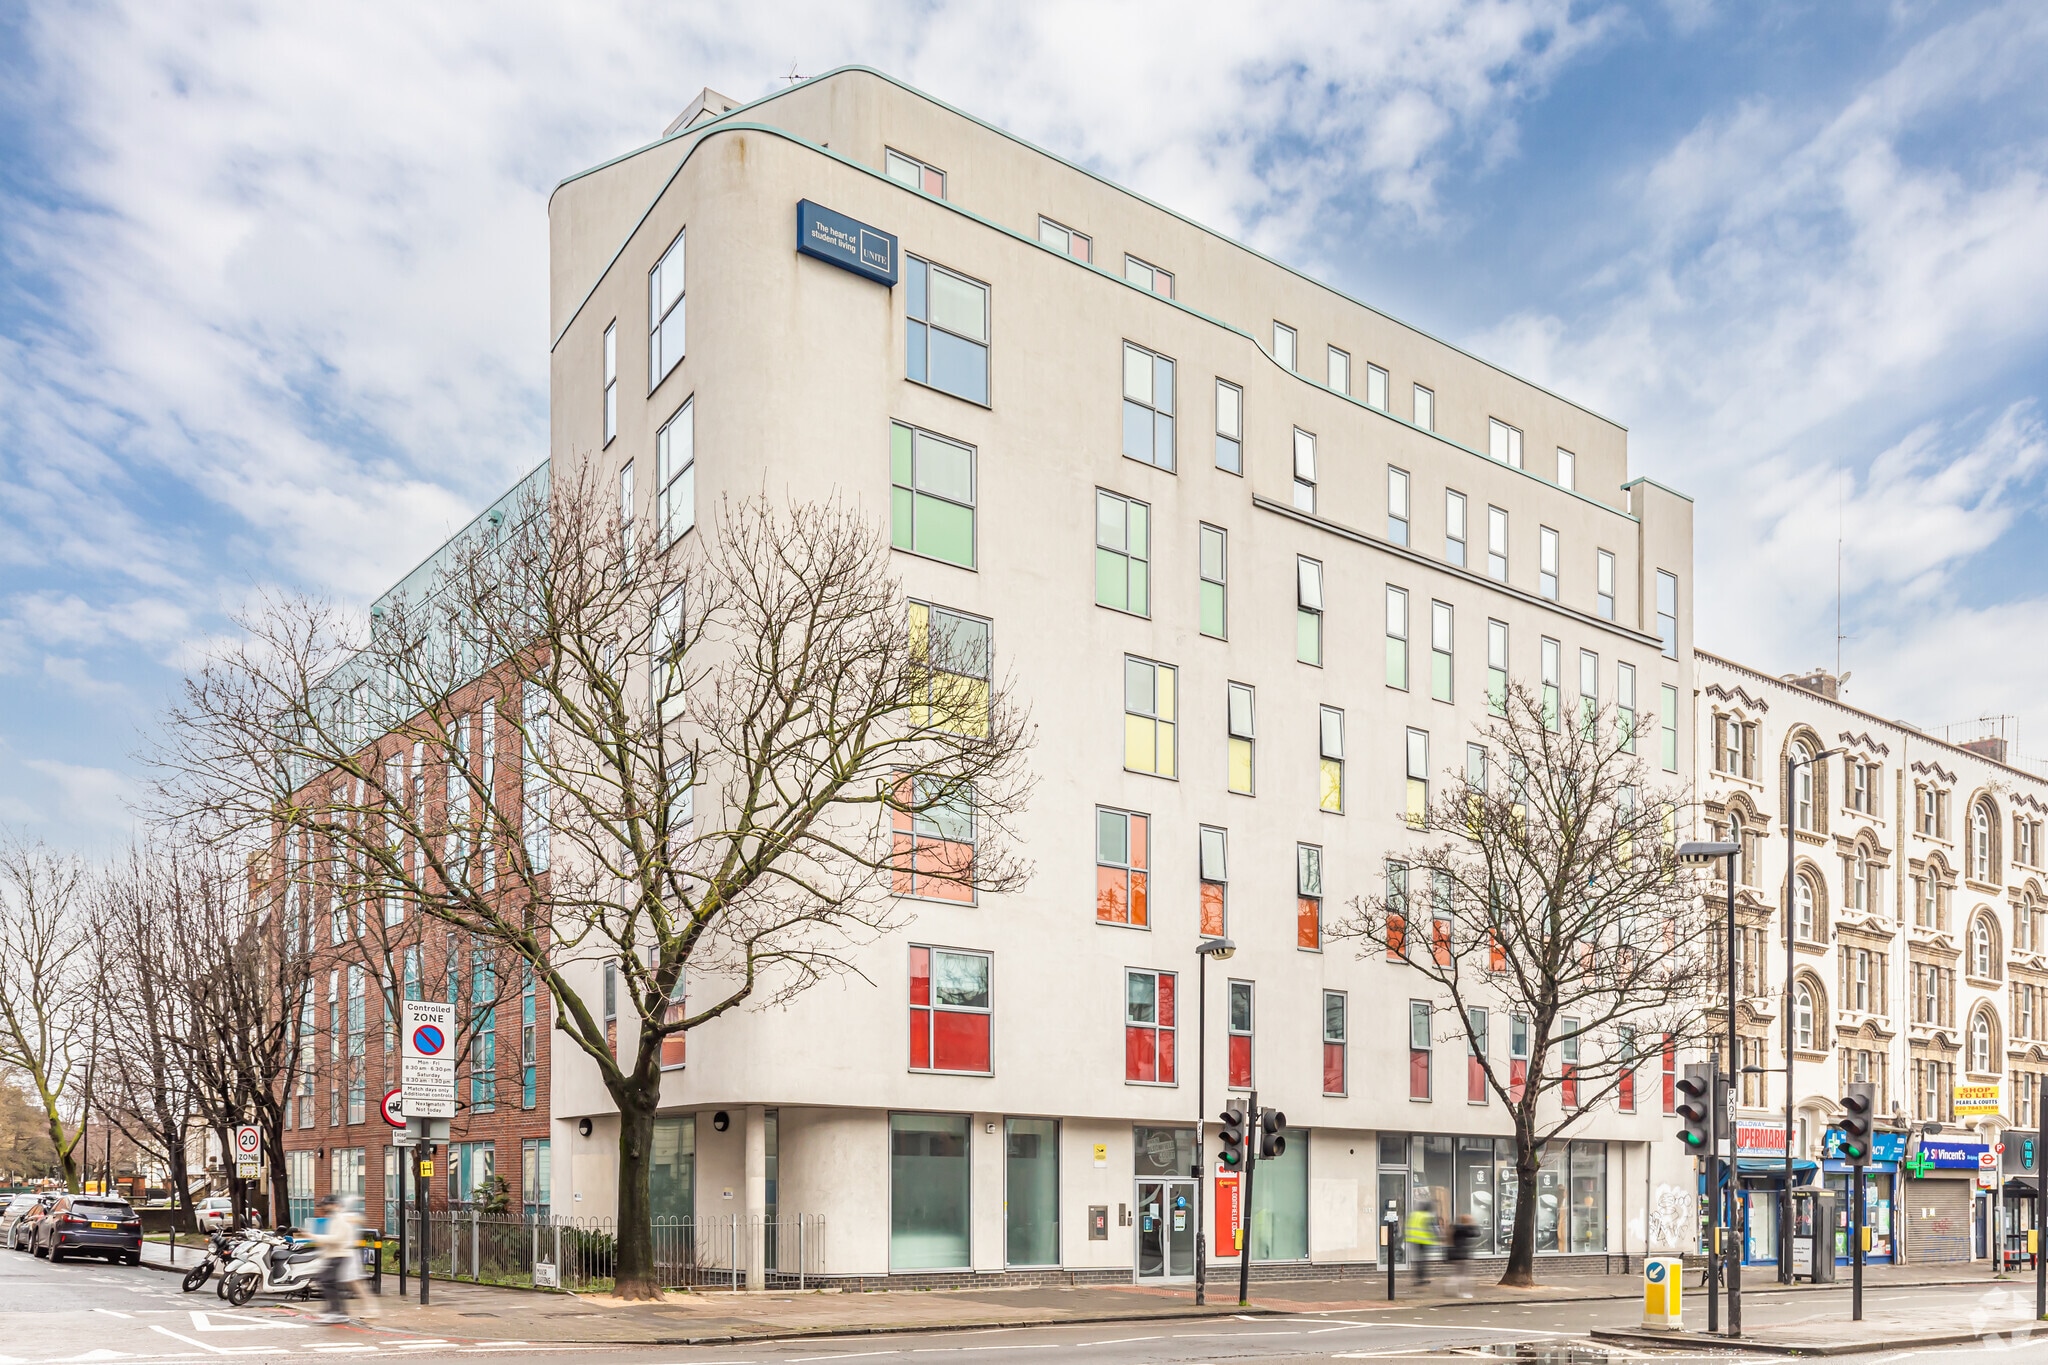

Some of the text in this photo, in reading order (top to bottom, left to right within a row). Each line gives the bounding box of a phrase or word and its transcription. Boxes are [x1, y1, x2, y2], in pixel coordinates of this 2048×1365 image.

[816, 221, 856, 244] The heart of
[811, 230, 856, 254] student living
[863, 249, 887, 265] UNITE
[407, 1003, 451, 1013] Controlled
[413, 1013, 444, 1023] ZONE
[241, 1135, 256, 1146] 20
[1736, 1127, 1796, 1149] UPERMARKT
[1938, 1149, 1966, 1160] Vincent's
[422, 1163, 432, 1175] H
